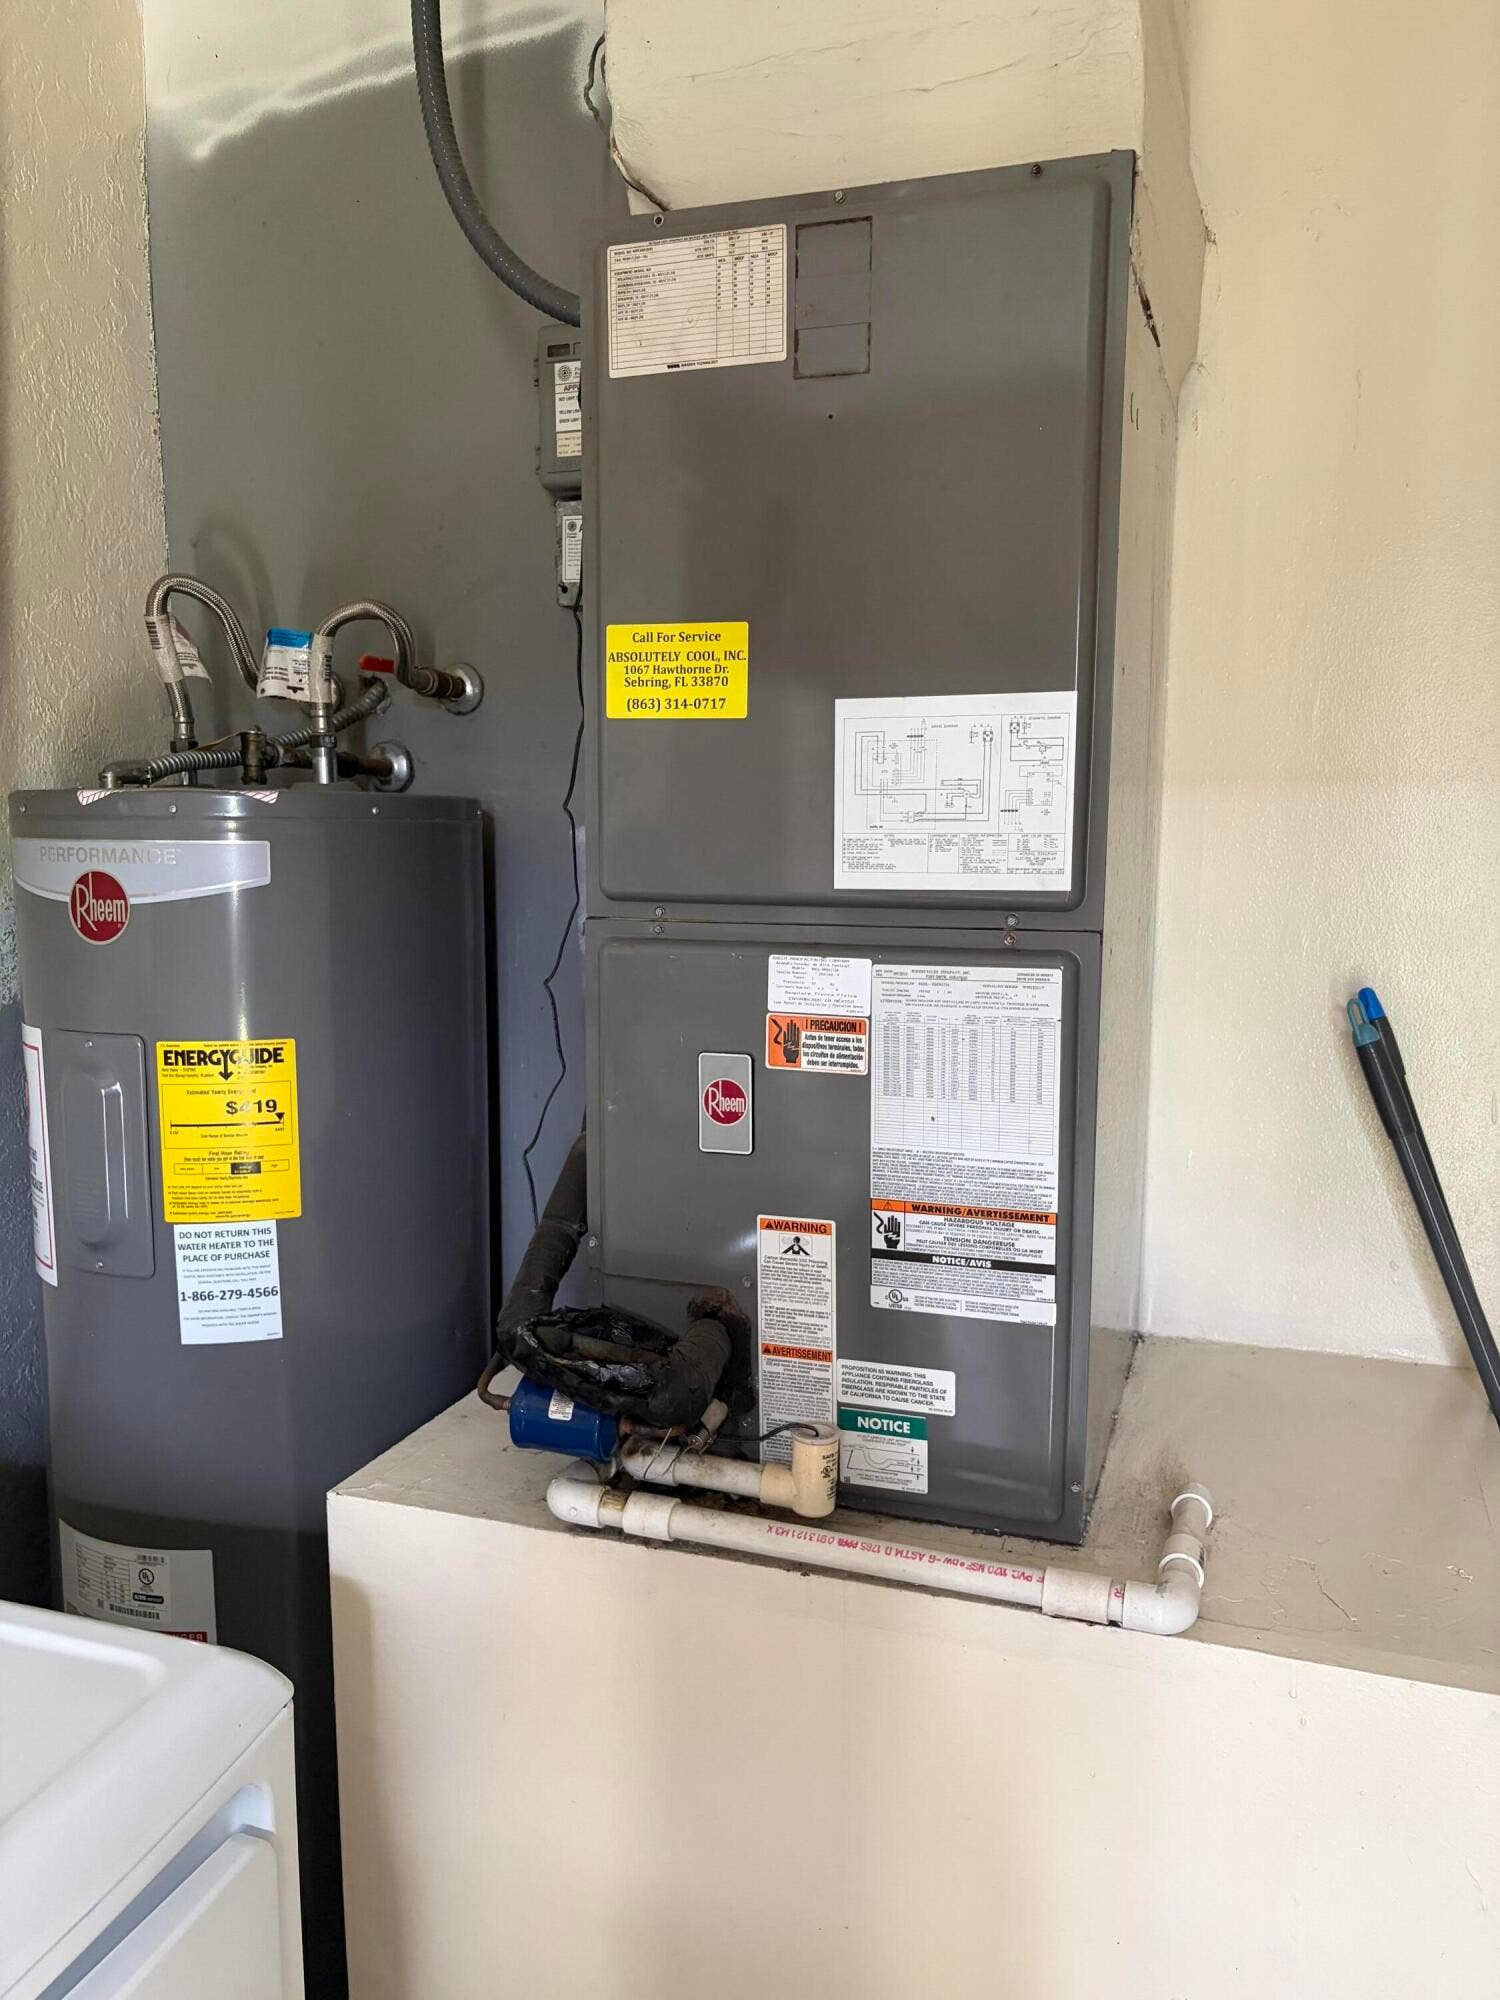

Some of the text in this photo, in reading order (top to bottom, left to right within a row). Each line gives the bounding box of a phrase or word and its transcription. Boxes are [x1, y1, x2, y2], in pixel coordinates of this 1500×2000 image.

[633, 631, 721, 642] Call For Service
[608, 651, 746, 662] ABSOLUTELY COOL, INC.
[624, 665, 729, 674] 1067 Hawthorne Dr.
[624, 676, 728, 689] Sebring, FL 33870
[627, 698, 726, 712] (863) 314-0717
[39, 847, 176, 865] PERFORMANCE
[75, 872, 127, 932] Rheem
[810, 1020, 856, 1032] PRECAUCION
[707, 1080, 745, 1118] Rheem
[912, 1204, 1050, 1222] WARNING/AVERTISSEMENT
[773, 1219, 827, 1234] WARNING
[985, 1220, 1015, 1228] VOLTAGE
[179, 1231, 192, 1239] DO
[215, 1229, 250, 1238] RETURN
[253, 1227, 272, 1236] THIS
[178, 1243, 207, 1251] WATER
[209, 1241, 241, 1250] HEATER
[258, 1238, 274, 1247] THE
[183, 1250, 270, 1262] PLACE OF PURCHASE
[932, 1256, 992, 1268] NOTICE/AVIS
[180, 1286, 278, 1302] 1-866-279-4566
[772, 1345, 832, 1361] AVERTISSEMENT
[842, 1364, 877, 1373] PROPOSITION
[886, 1369, 912, 1378] WARNING:
[842, 1371, 871, 1379] APPLIANCE
[900, 1378, 934, 1386] FIBERGLASS
[842, 1384, 874, 1392] FIBERGLASS
[857, 1417, 910, 1433] NOTICE
[861, 1542, 881, 1553] 1785
[885, 1546, 892, 1556] D
[895, 1548, 926, 1561] ASTM
[966, 1561, 985, 1572] NSF
[1012, 1569, 1033, 1582] PVC
